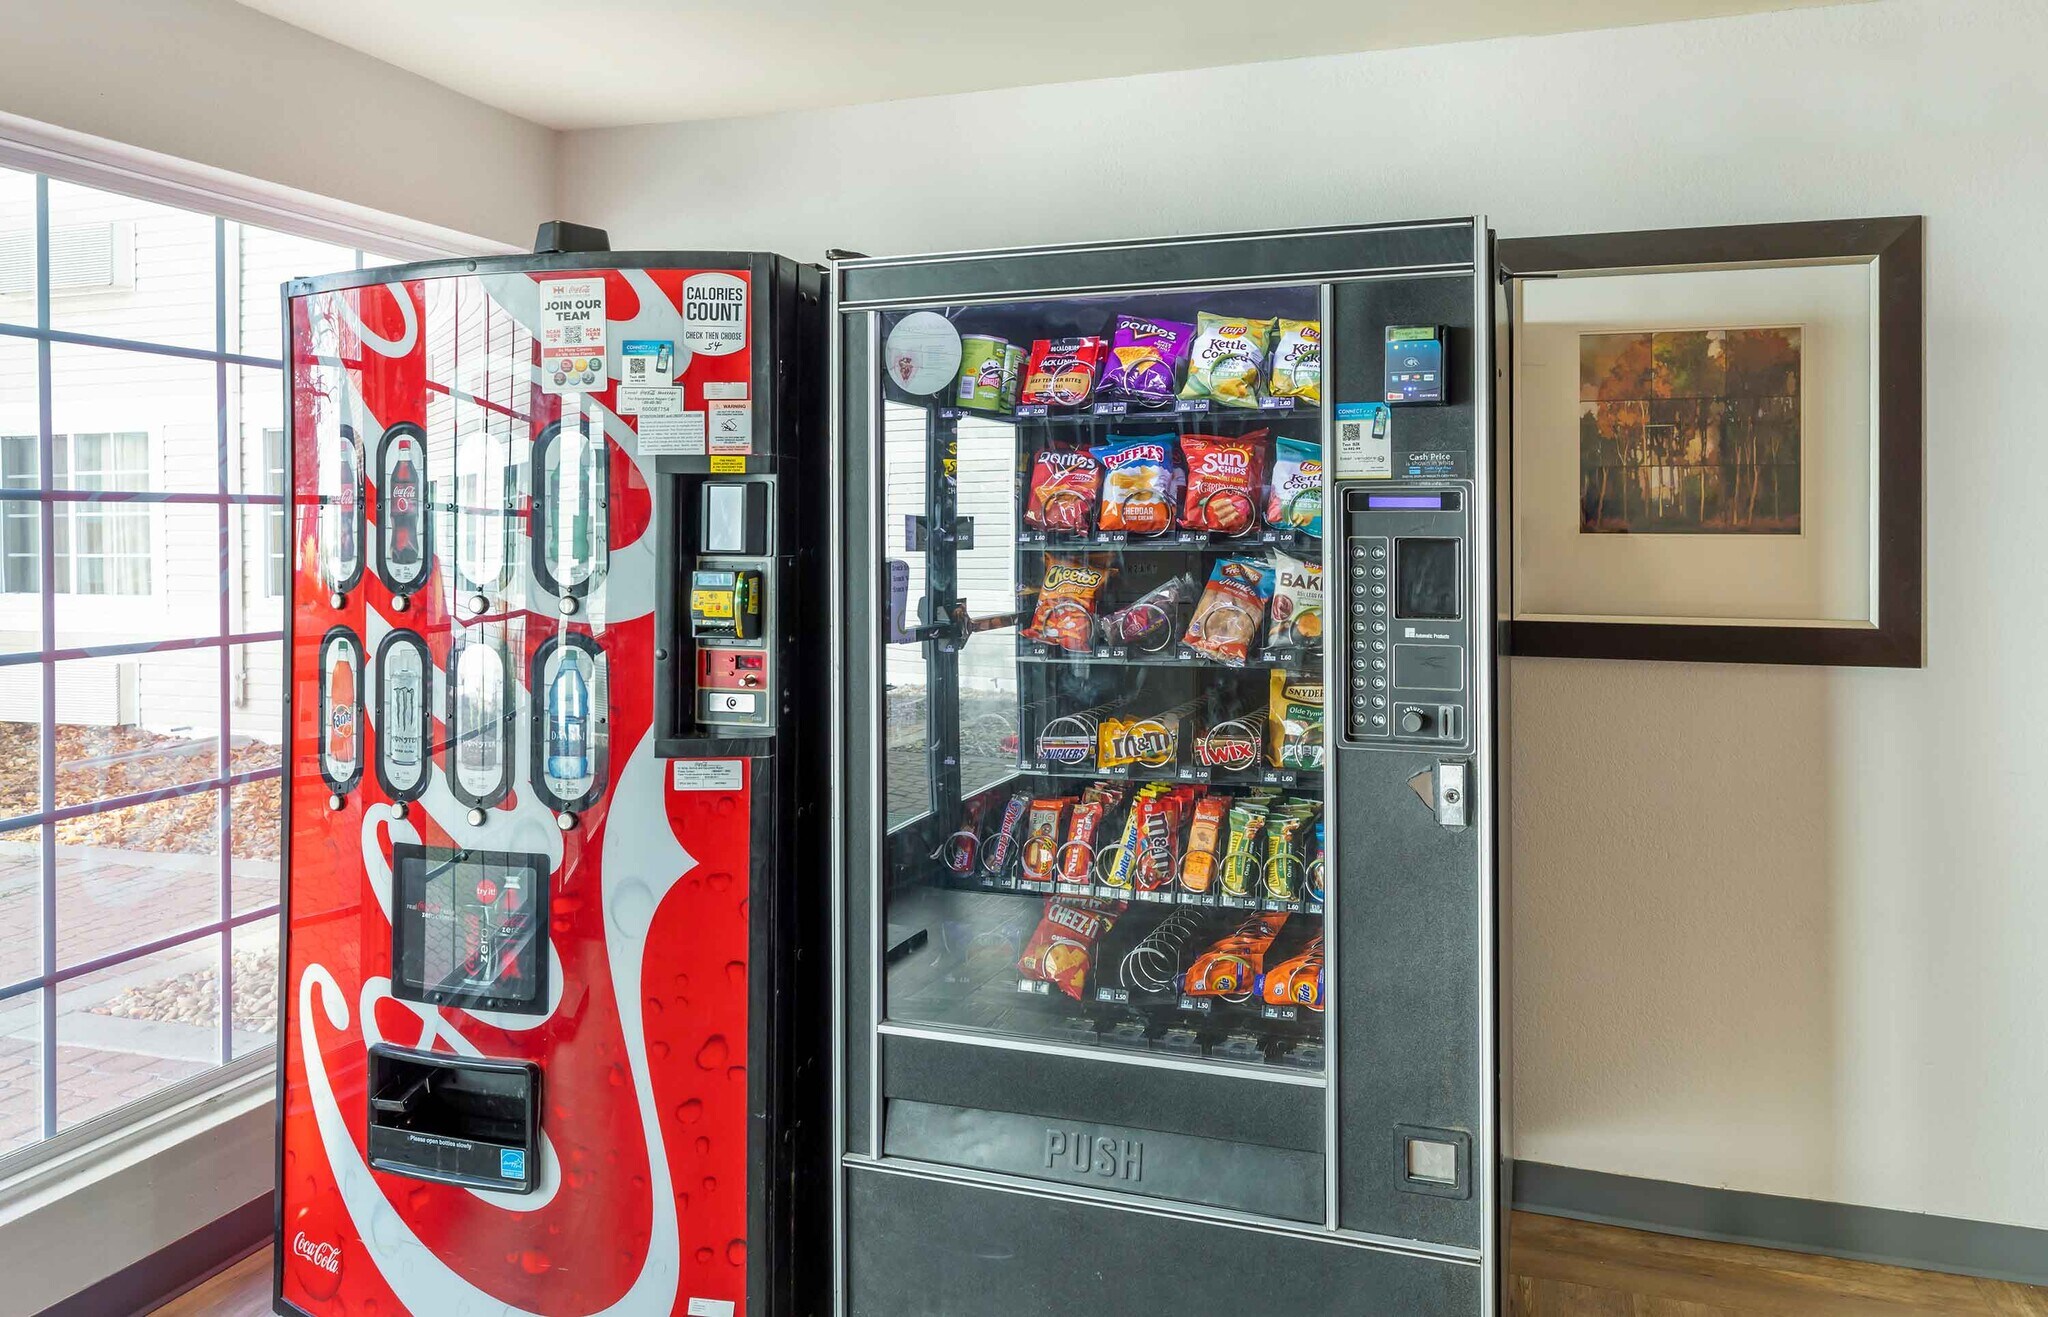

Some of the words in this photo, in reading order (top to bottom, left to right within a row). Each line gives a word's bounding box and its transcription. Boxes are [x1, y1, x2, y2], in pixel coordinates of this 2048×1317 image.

[687, 287, 743, 301] CALORIES
[545, 301, 572, 311] JOIN
[575, 299, 602, 309] OUR
[687, 302, 743, 321] COUNT
[555, 311, 590, 322] TEAM
[685, 331, 704, 340] CHECK
[705, 332, 720, 340] THEN
[720, 332, 742, 341] CHOOSE
[1120, 320, 1177, 341] Doritos
[1302, 326, 1320, 339] Lay
[1210, 338, 1247, 351] Kettle
[1293, 343, 1320, 355] Kett
[1065, 376, 1082, 384] BITES
[1038, 451, 1096, 469] Doritos
[1103, 444, 1164, 470] RUFFLES
[1408, 453, 1429, 461] Cash
[1430, 453, 1451, 461] Price
[1218, 466, 1247, 475] CHIPS
[1043, 565, 1102, 589] Cheetos
[1289, 706, 1306, 715] Olde
[1403, 705, 1424, 715] return
[1068, 847, 1079, 873] Nut
[477, 887, 488, 896] try
[488, 888, 497, 896] it!
[480, 928, 489, 963] zero
[1298, 983, 1312, 1003] Tide
[409, 1134, 426, 1143] Please
[426, 1137, 438, 1146] open
[438, 1138, 456, 1148] bottles
[455, 1141, 472, 1151] slowly
[1045, 1129, 1144, 1182] PUSH
